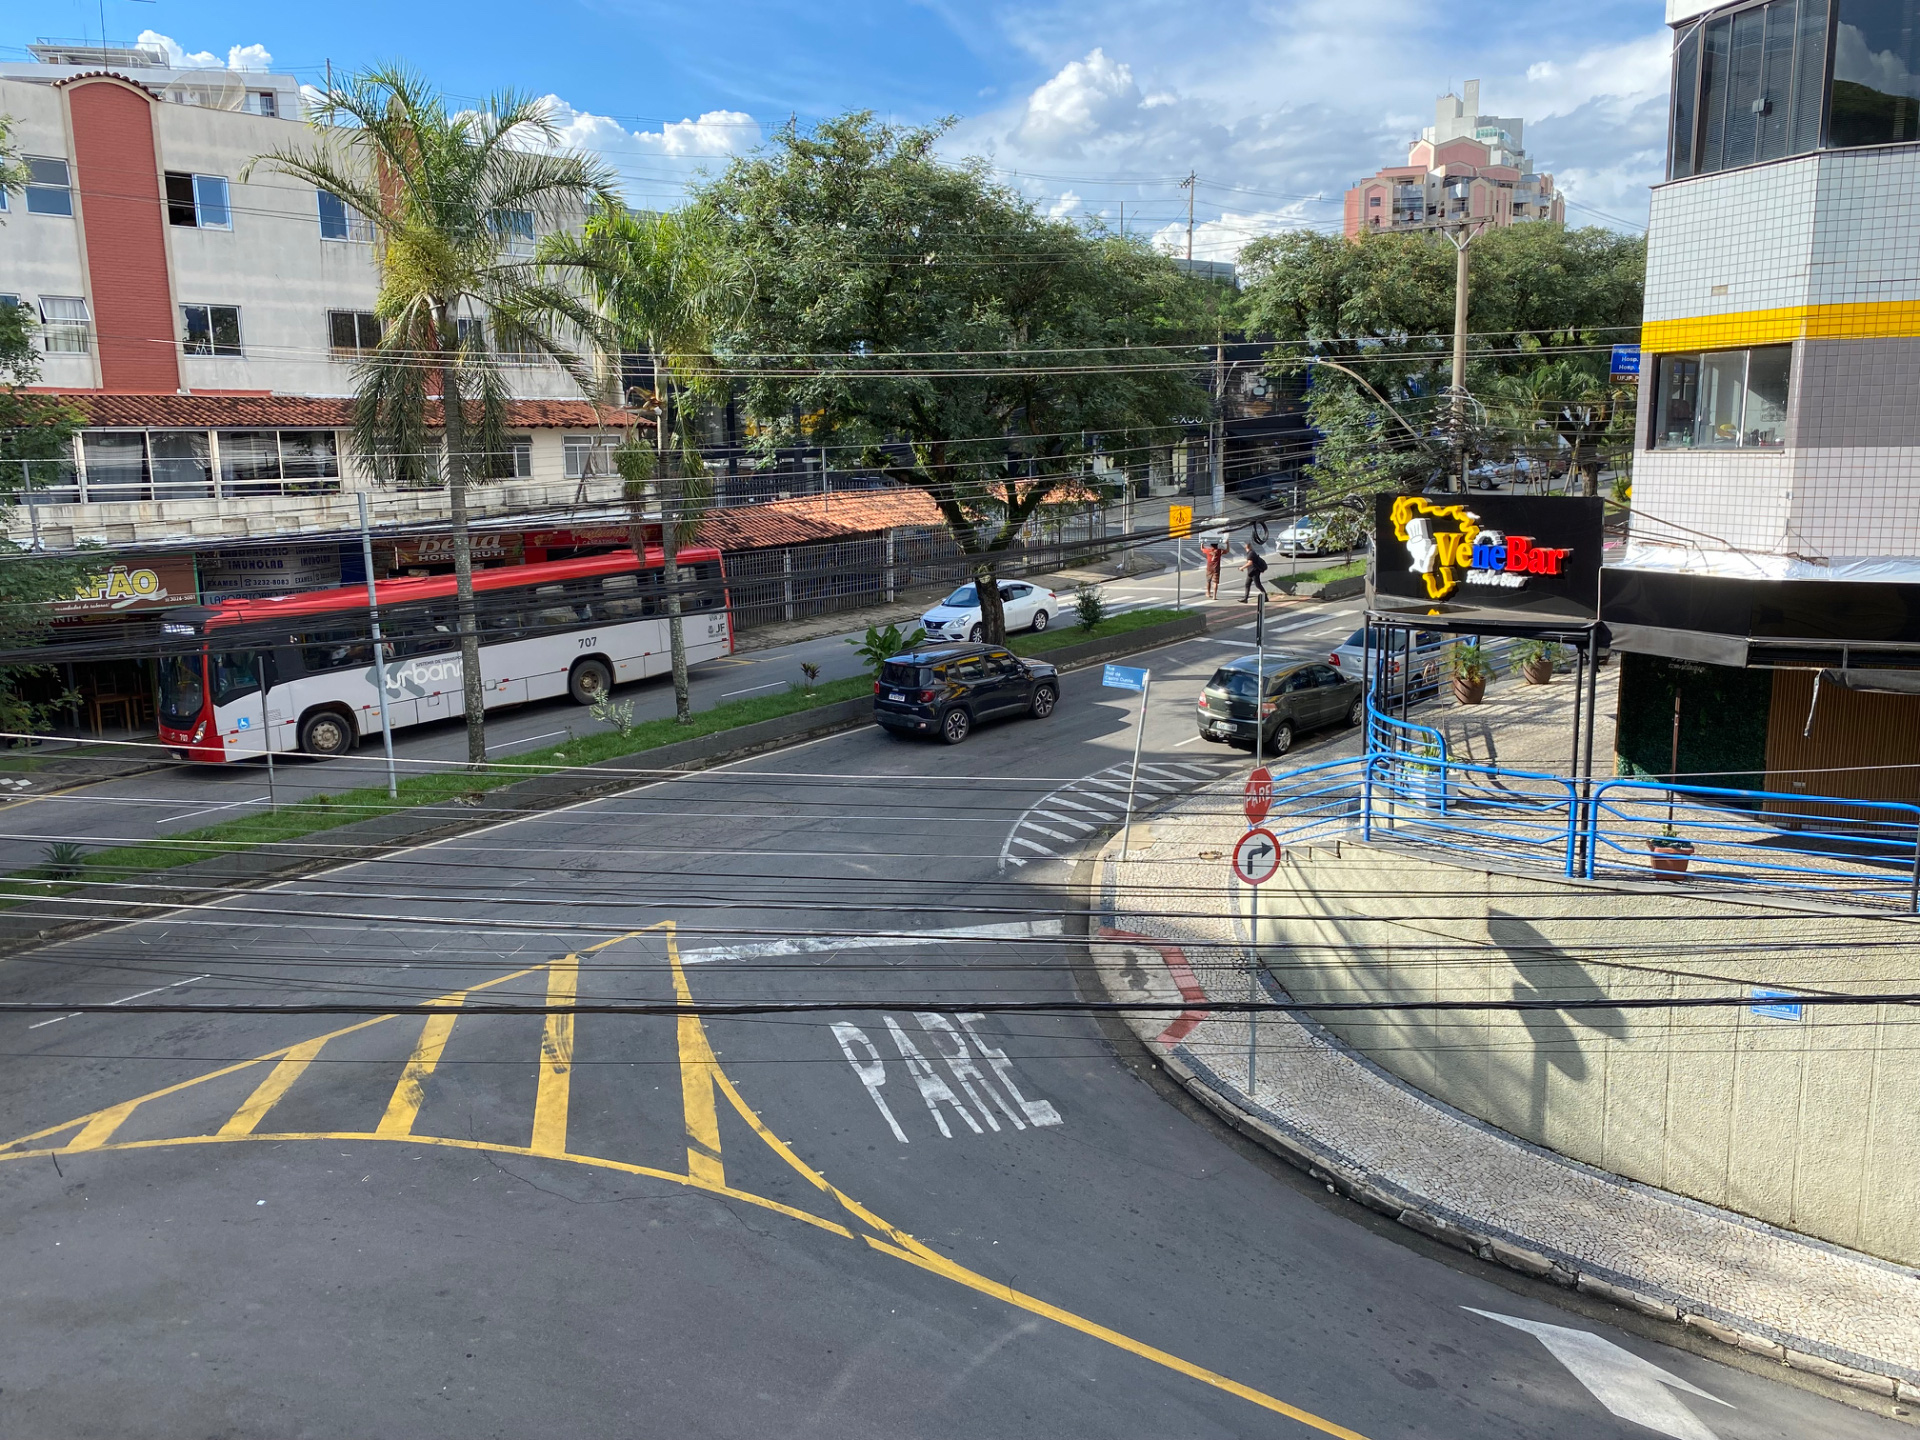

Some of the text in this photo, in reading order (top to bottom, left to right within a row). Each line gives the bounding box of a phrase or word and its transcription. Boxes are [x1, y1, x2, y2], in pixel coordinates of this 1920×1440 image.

[1433, 532, 1570, 575] VeneBar
[228, 560, 284, 570] IMUNOLAB
[207, 579, 238, 587] EXAMES
[715, 622, 725, 633] JF
[578, 636, 597, 649] 707
[386, 661, 464, 689] urban
[828, 1011, 1064, 1144] PARE
